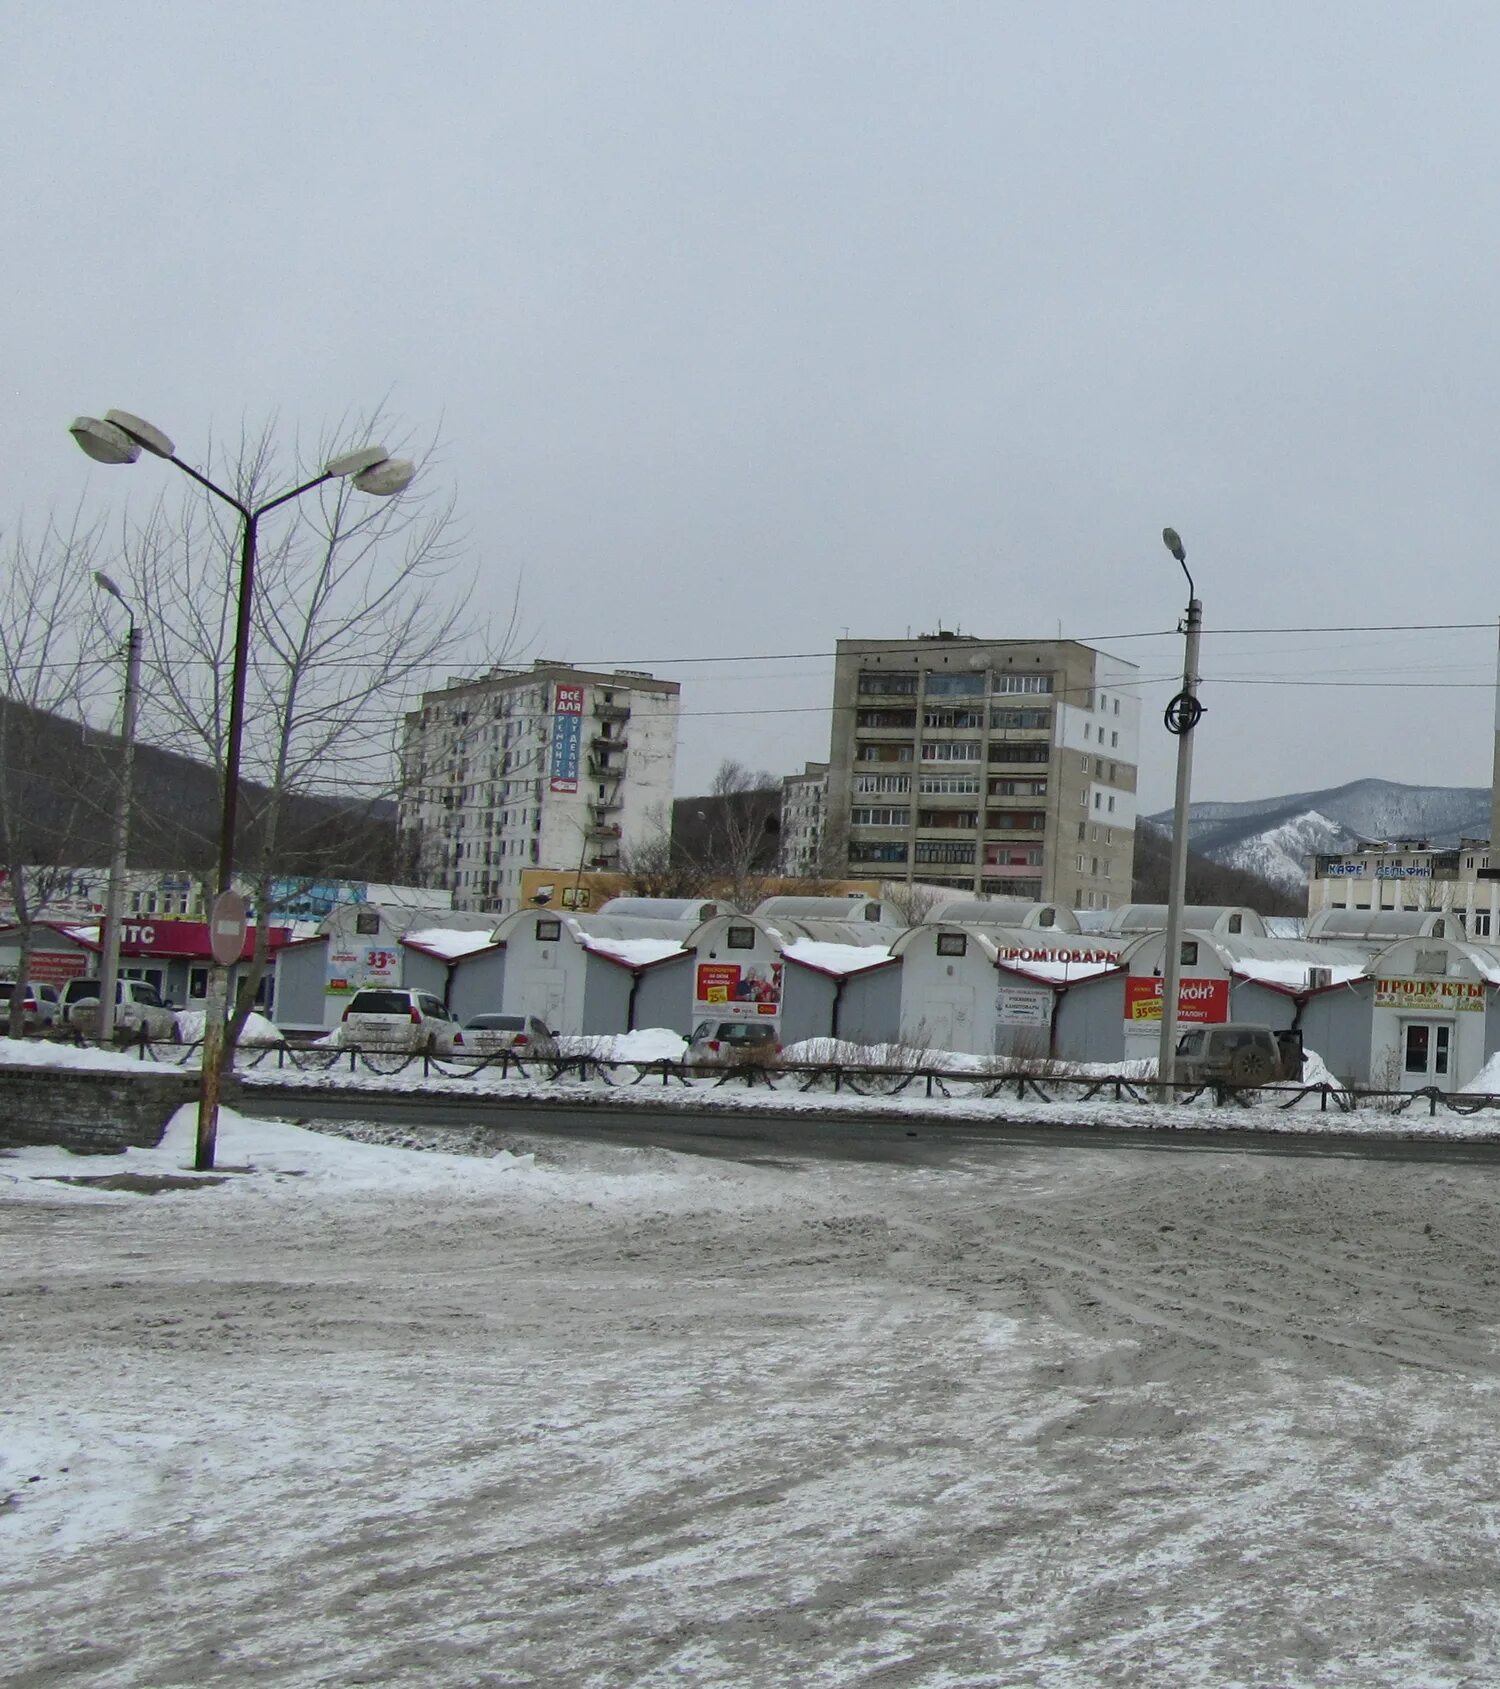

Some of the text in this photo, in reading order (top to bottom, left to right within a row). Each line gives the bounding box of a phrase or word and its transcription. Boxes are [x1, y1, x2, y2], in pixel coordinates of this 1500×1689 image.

[560, 690, 581, 702] ВСЁ
[557, 701, 581, 712] ДЛЯ
[567, 716, 579, 778] ОТДЕЛКИ
[1328, 863, 1432, 878] КАФЕ ДЕЛЬФИН
[998, 947, 1121, 964] ПРОМТОВАРЫ
[1154, 982, 1215, 1000] БКОН?
[1376, 979, 1485, 998] ПРОДУКТЫ
